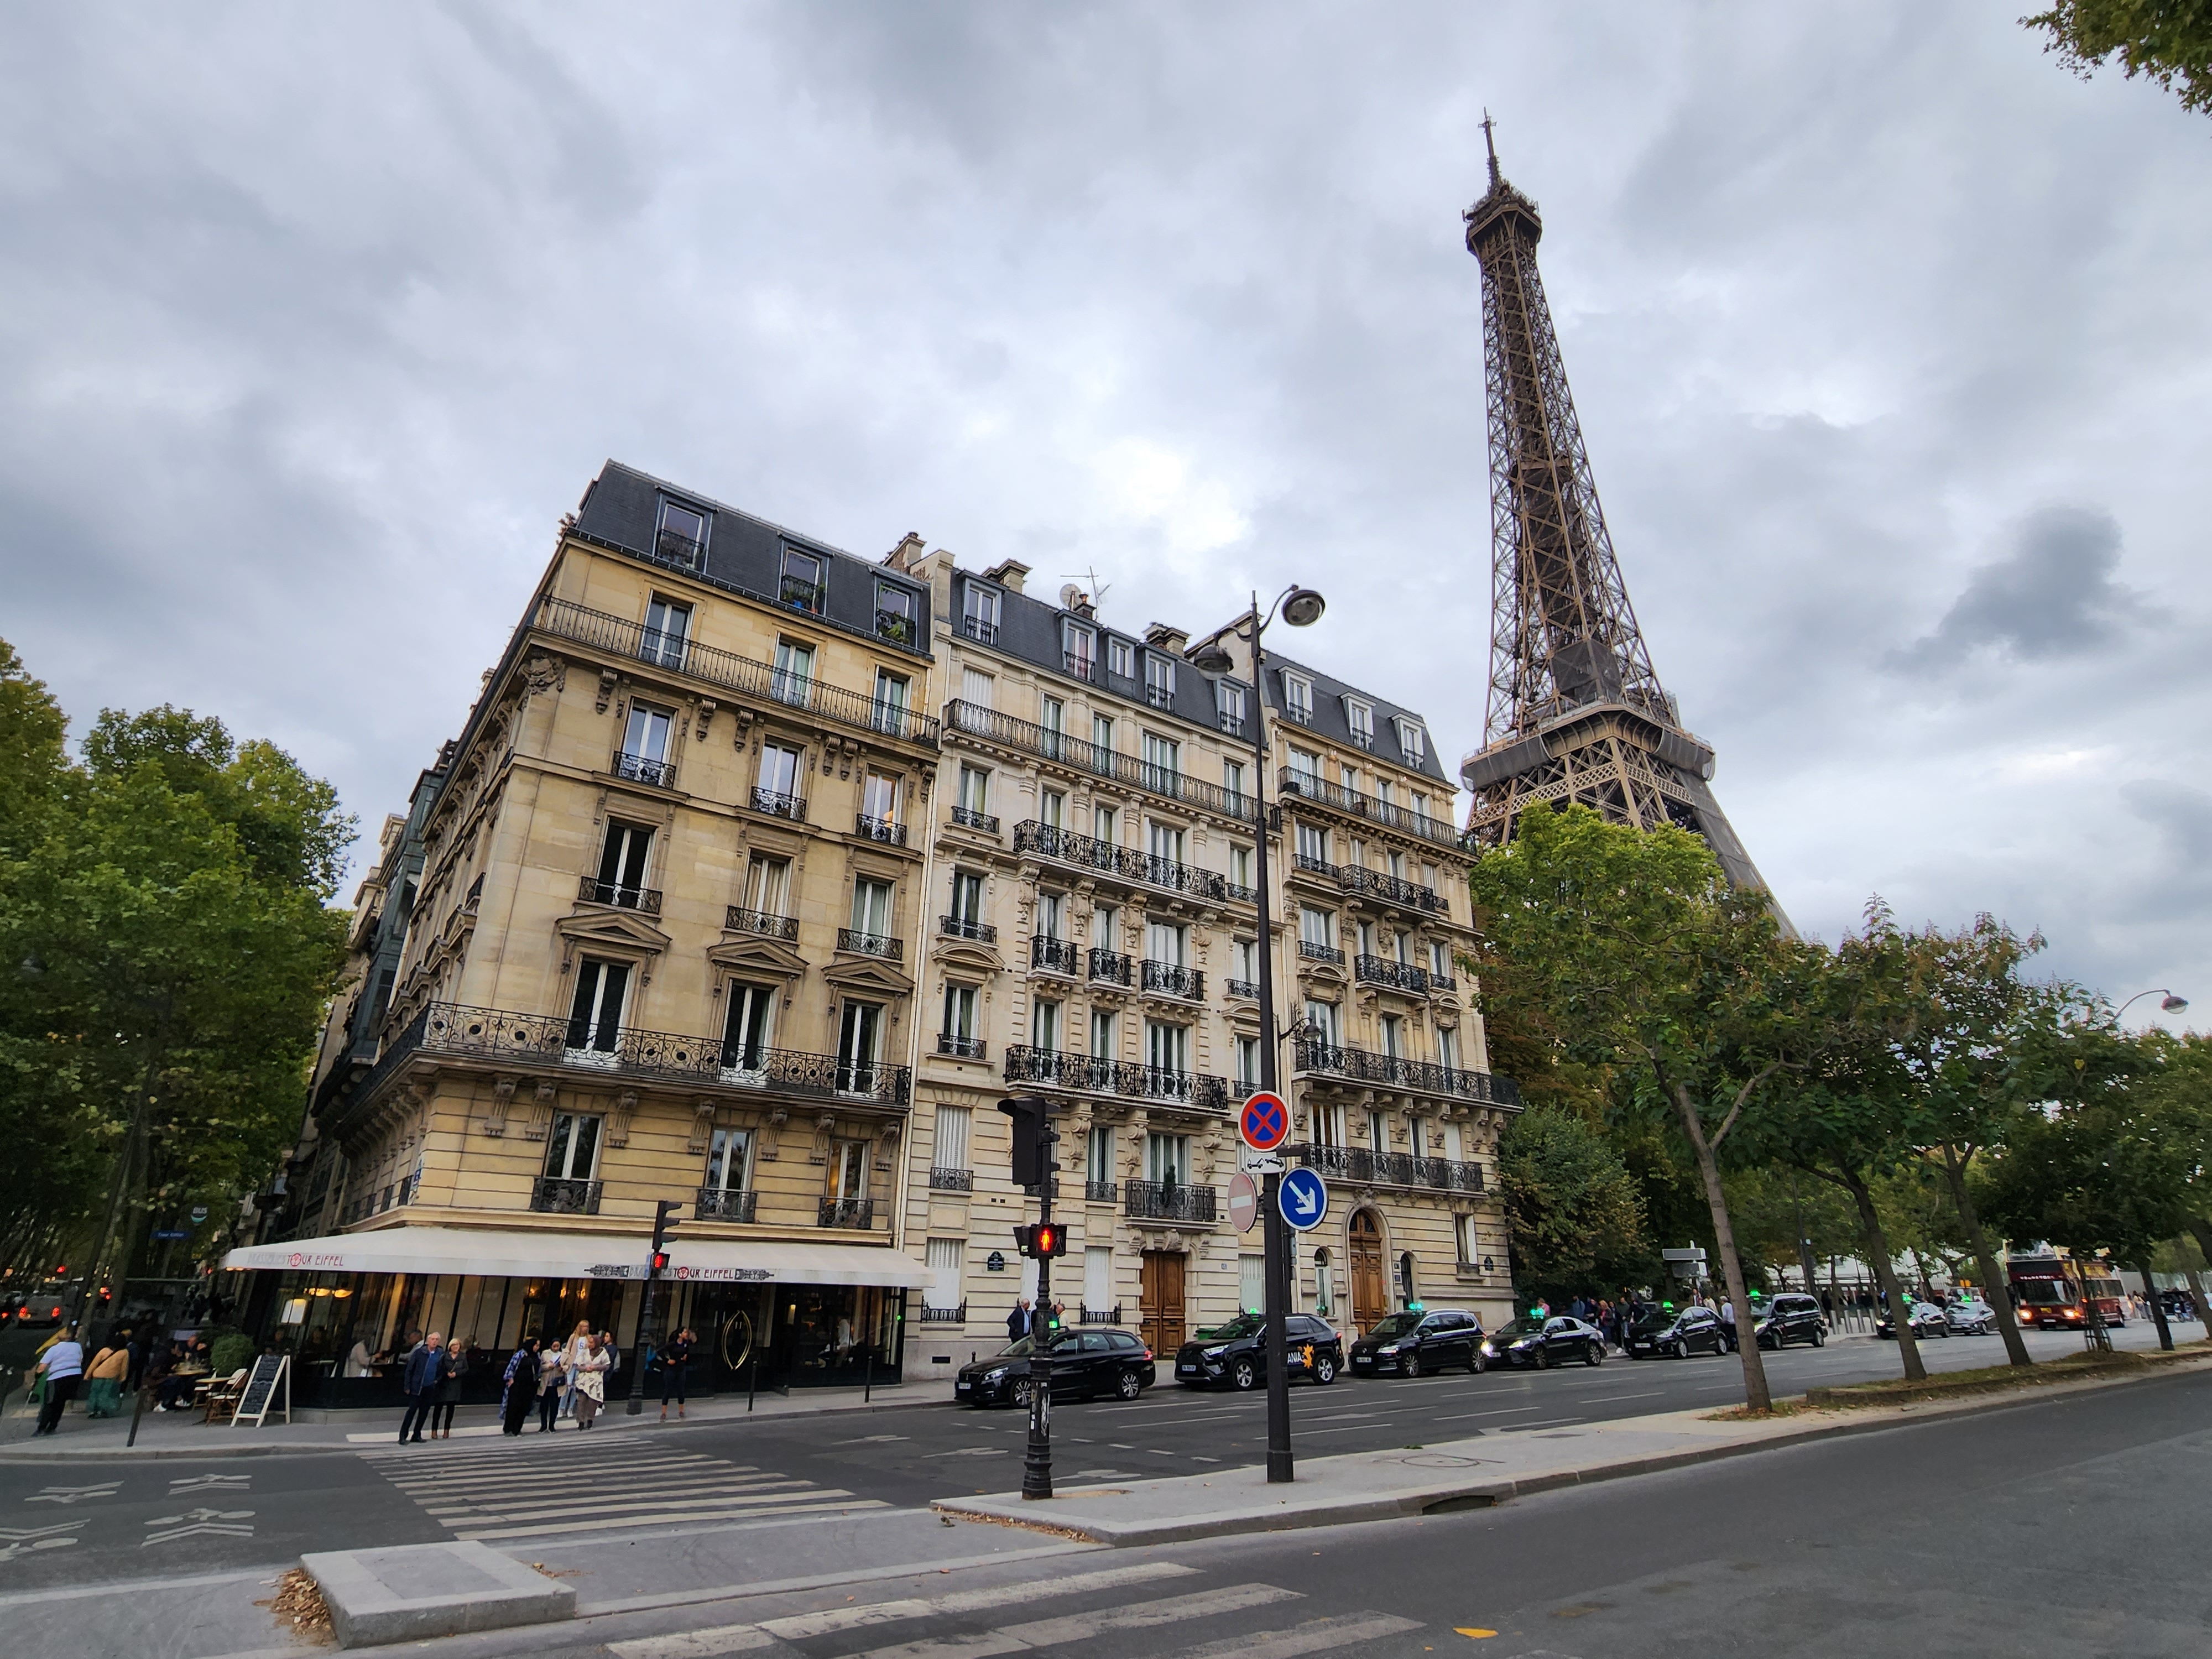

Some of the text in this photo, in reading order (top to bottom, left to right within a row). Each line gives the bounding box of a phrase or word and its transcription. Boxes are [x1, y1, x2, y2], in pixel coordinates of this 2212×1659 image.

[287, 1253, 311, 1267] TOUR
[315, 1255, 343, 1266] EIFFEL
[674, 1266, 701, 1279] TOUR
[703, 1269, 734, 1279] EIFFEL
